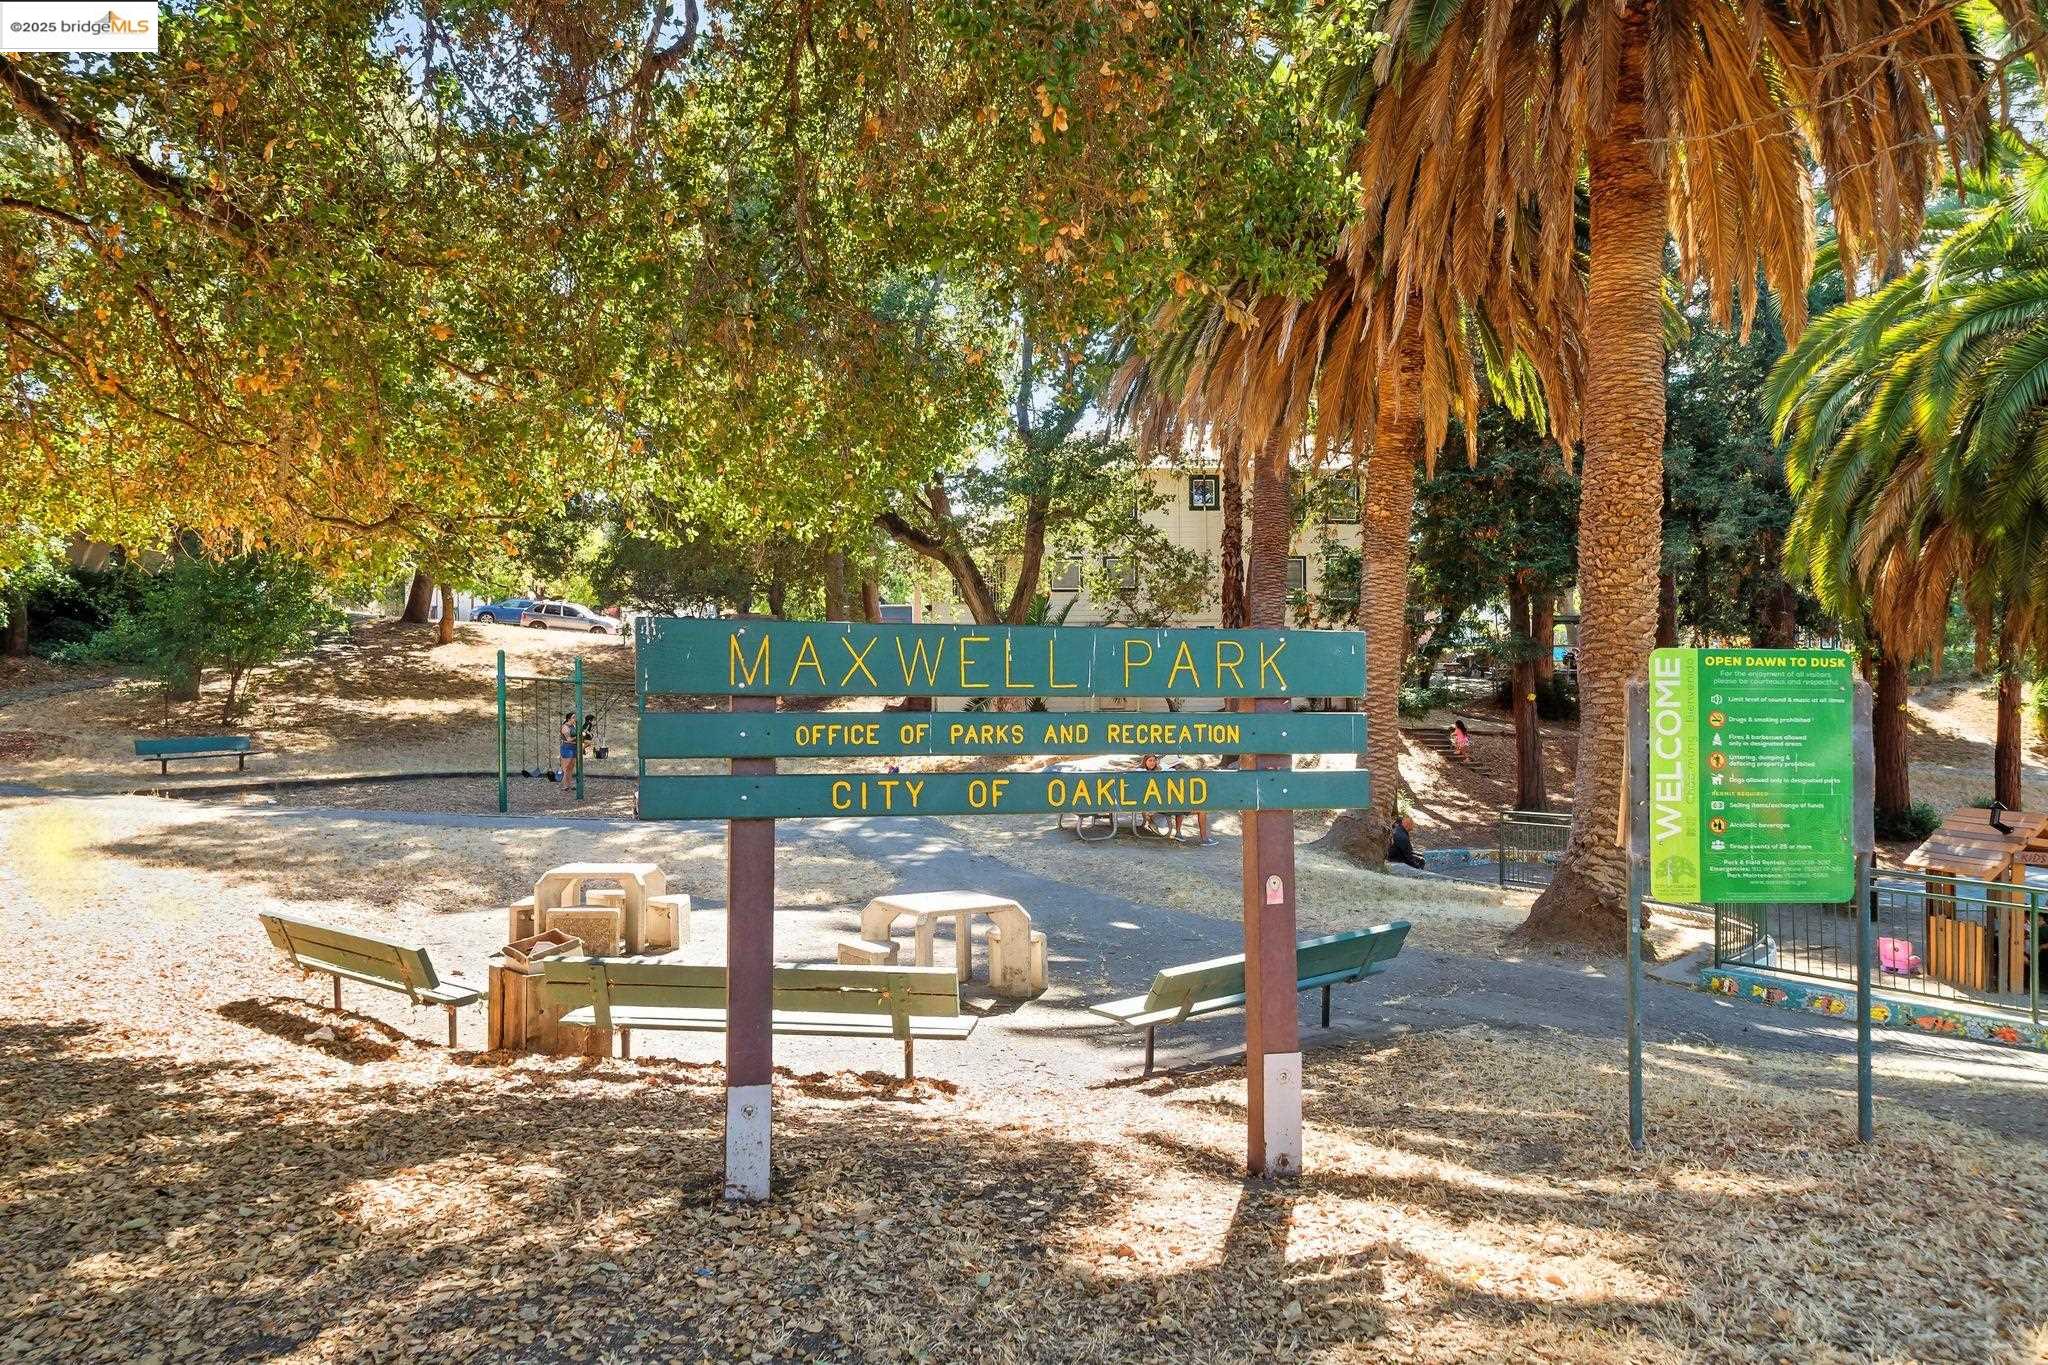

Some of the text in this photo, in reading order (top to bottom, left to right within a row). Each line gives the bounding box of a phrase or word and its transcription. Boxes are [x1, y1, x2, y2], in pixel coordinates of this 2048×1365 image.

[729, 633, 1289, 690] MAXWELL PARK
[1704, 657, 1846, 667] OPEN DAWN TO DUSK
[795, 723, 1241, 746] OFFICE OF PARKS AND RECREATION
[1654, 656, 1684, 842] WELCOME
[831, 776, 1208, 810] CITY OF OAKLAND
